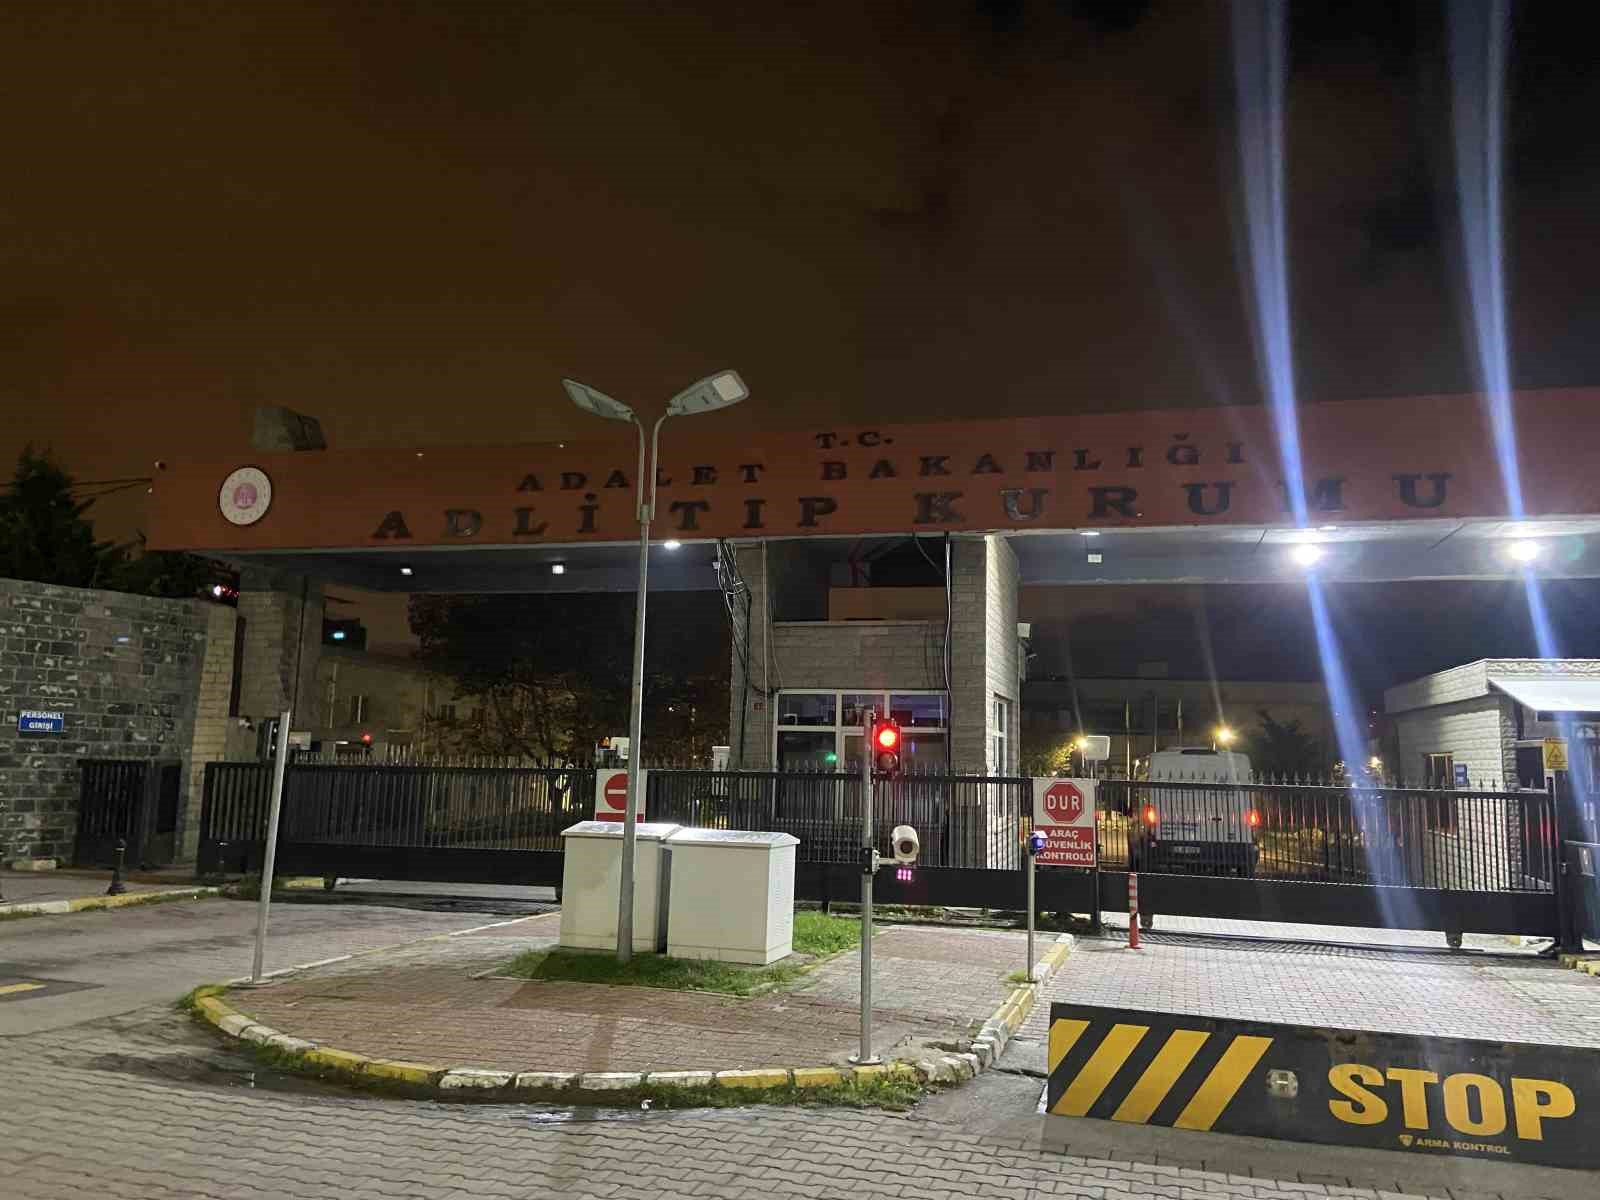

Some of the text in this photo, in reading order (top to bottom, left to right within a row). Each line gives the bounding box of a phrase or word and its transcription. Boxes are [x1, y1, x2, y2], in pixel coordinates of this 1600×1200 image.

[815, 431, 893, 449] T.C.
[515, 433, 1246, 493] ADALET BAKANLIĞI
[372, 474, 1454, 539] ADLİ TIP KURUMU
[1047, 795, 1081, 811] DUR
[1050, 829, 1080, 840] ARAÇ
[1327, 1063, 1576, 1140] STOP
[1416, 1138, 1512, 1154] ARMA KONTROL
